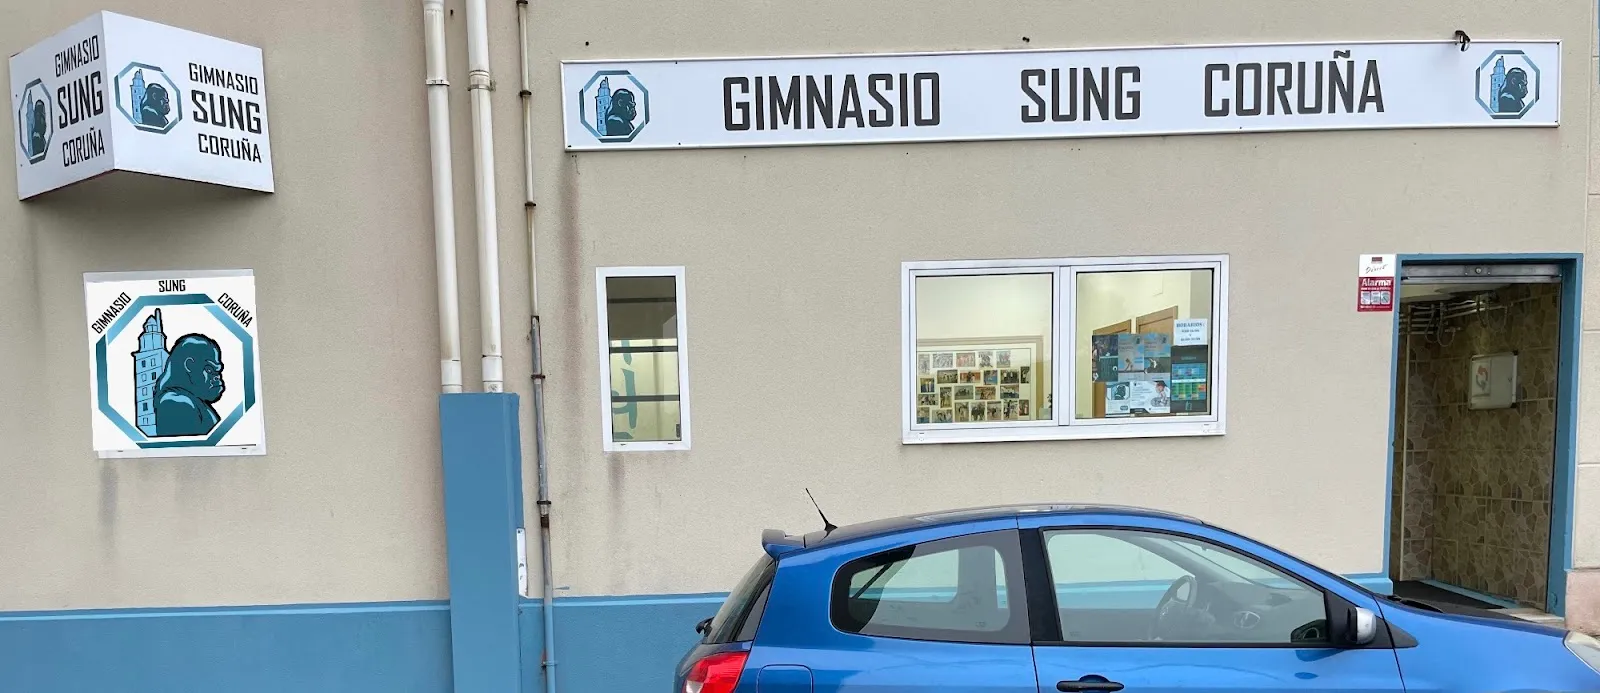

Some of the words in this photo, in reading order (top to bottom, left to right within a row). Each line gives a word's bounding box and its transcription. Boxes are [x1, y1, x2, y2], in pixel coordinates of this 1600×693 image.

[54, 35, 100, 78] GIMNASIO
[57, 70, 104, 129] SUNG
[188, 62, 259, 96] GIMNASIO
[723, 71, 941, 132] GIMNASIO
[1020, 66, 1141, 123] SUNG
[1203, 49, 1385, 117] CORUÑA
[191, 90, 262, 135] SUNG
[62, 127, 105, 167] CORUÑA
[198, 133, 262, 163] CORUÑA
[1361, 278, 1392, 287] Alarma
[91, 291, 132, 334] GIMNASIO
[158, 279, 186, 292] SUNG
[217, 292, 253, 328] CORUÑA
